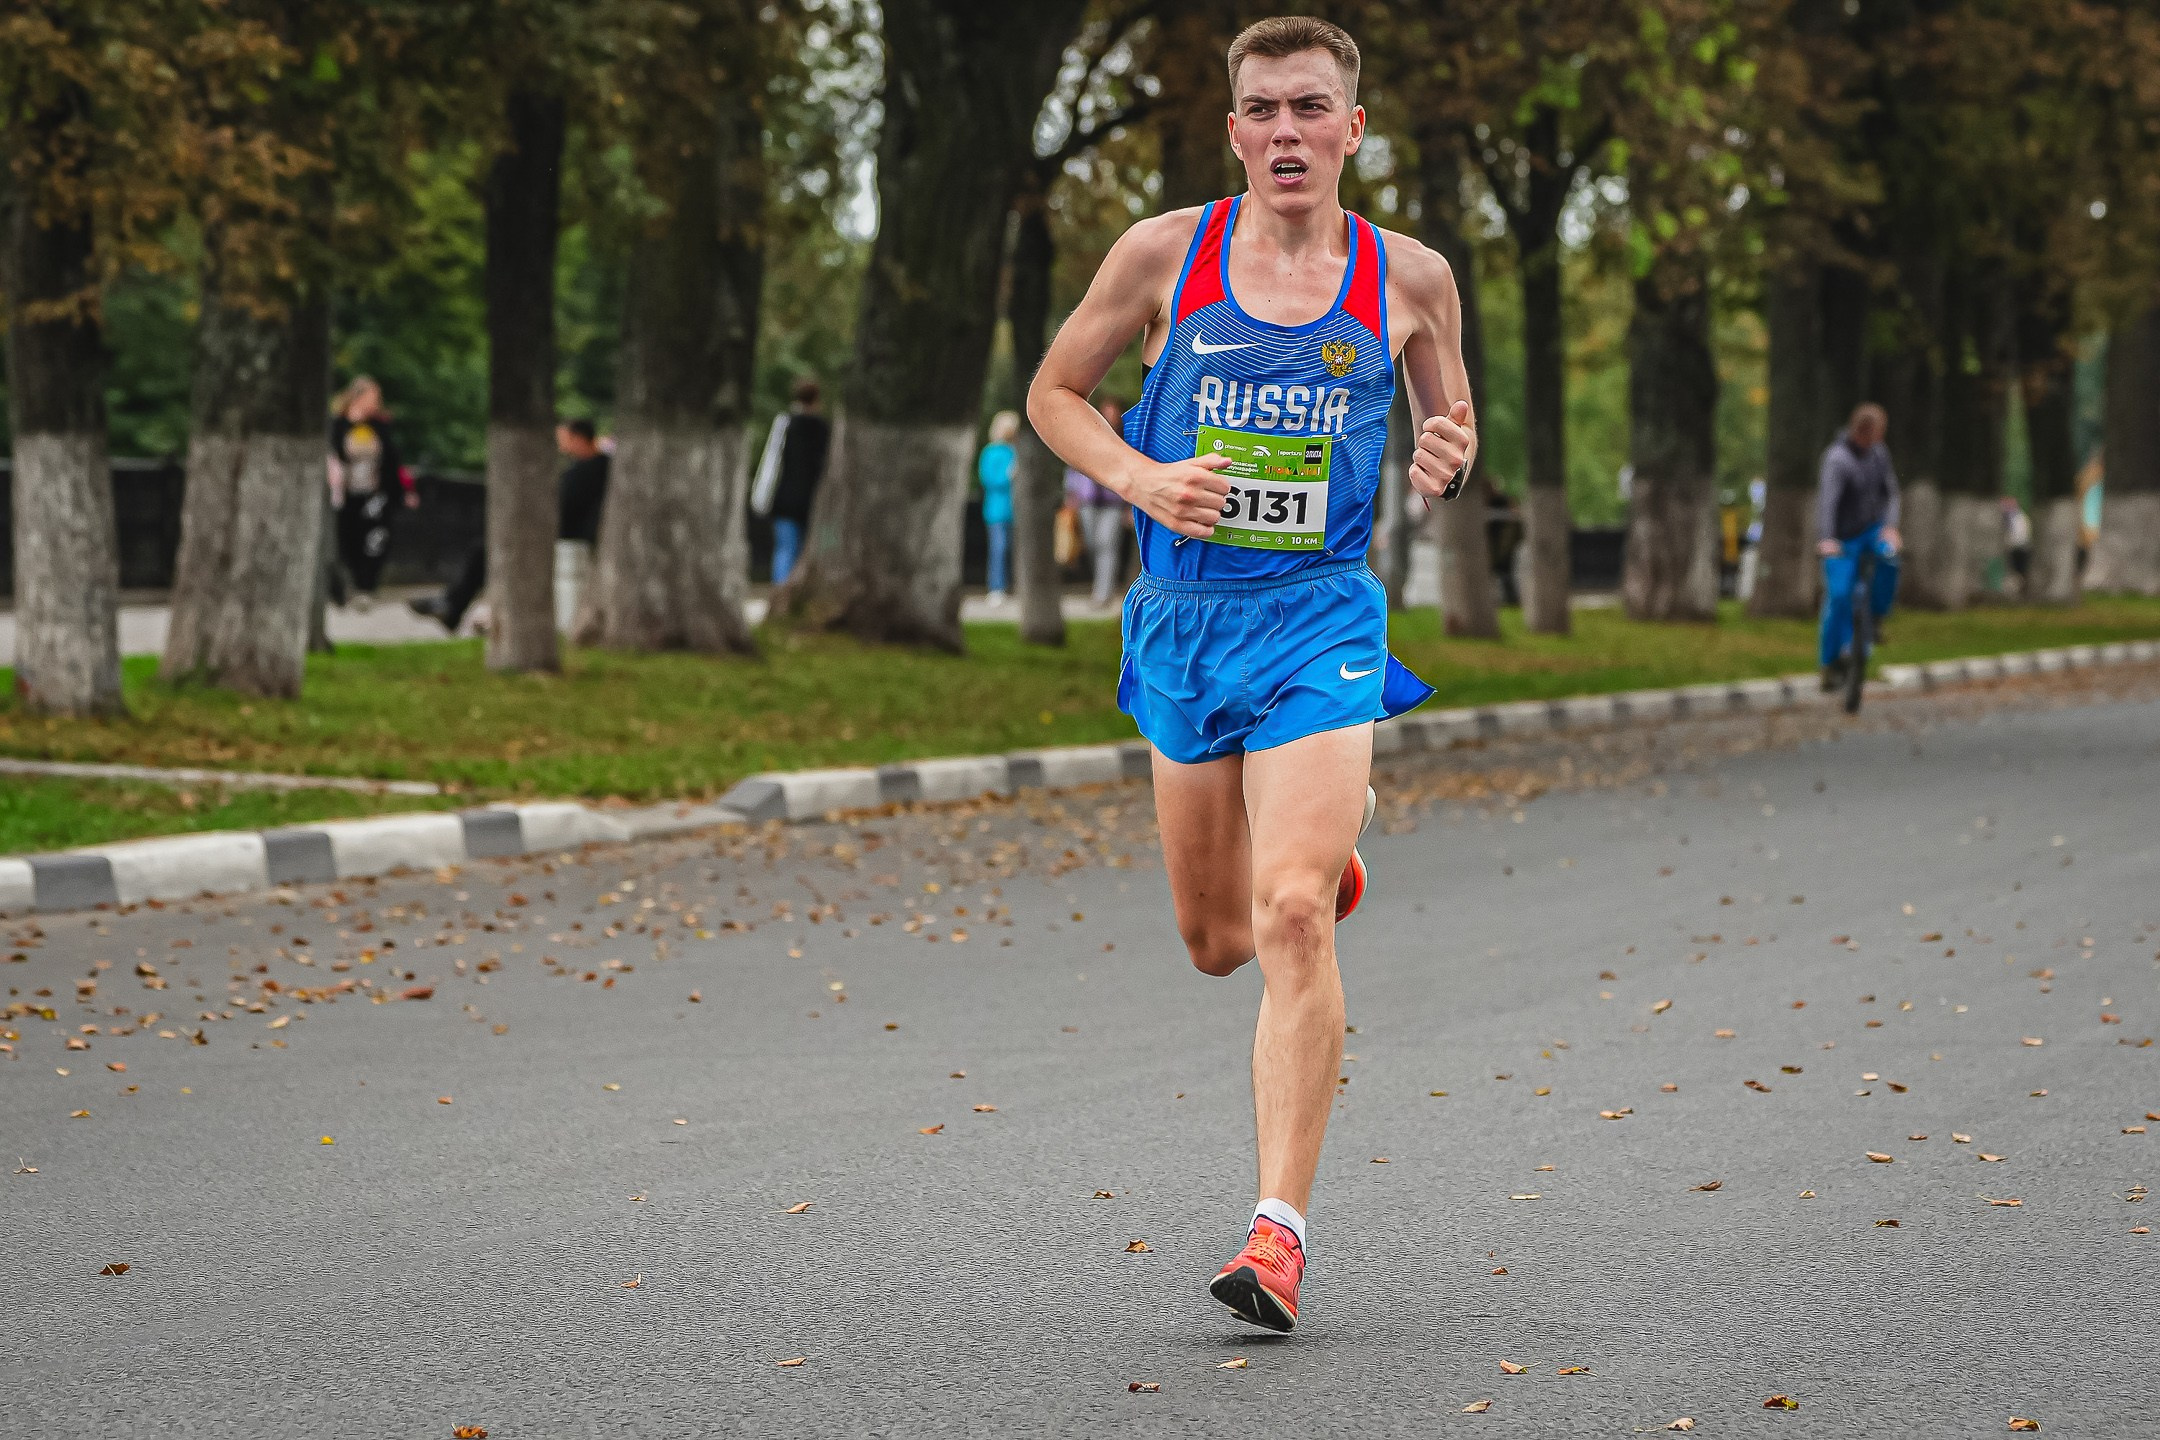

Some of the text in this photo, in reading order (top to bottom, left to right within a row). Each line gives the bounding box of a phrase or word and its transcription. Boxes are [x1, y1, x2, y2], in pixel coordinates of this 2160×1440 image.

[1193, 375, 1350, 433] RUSSIA
[1220, 485, 1308, 525] 6131
[1291, 536, 1302, 545] 10
